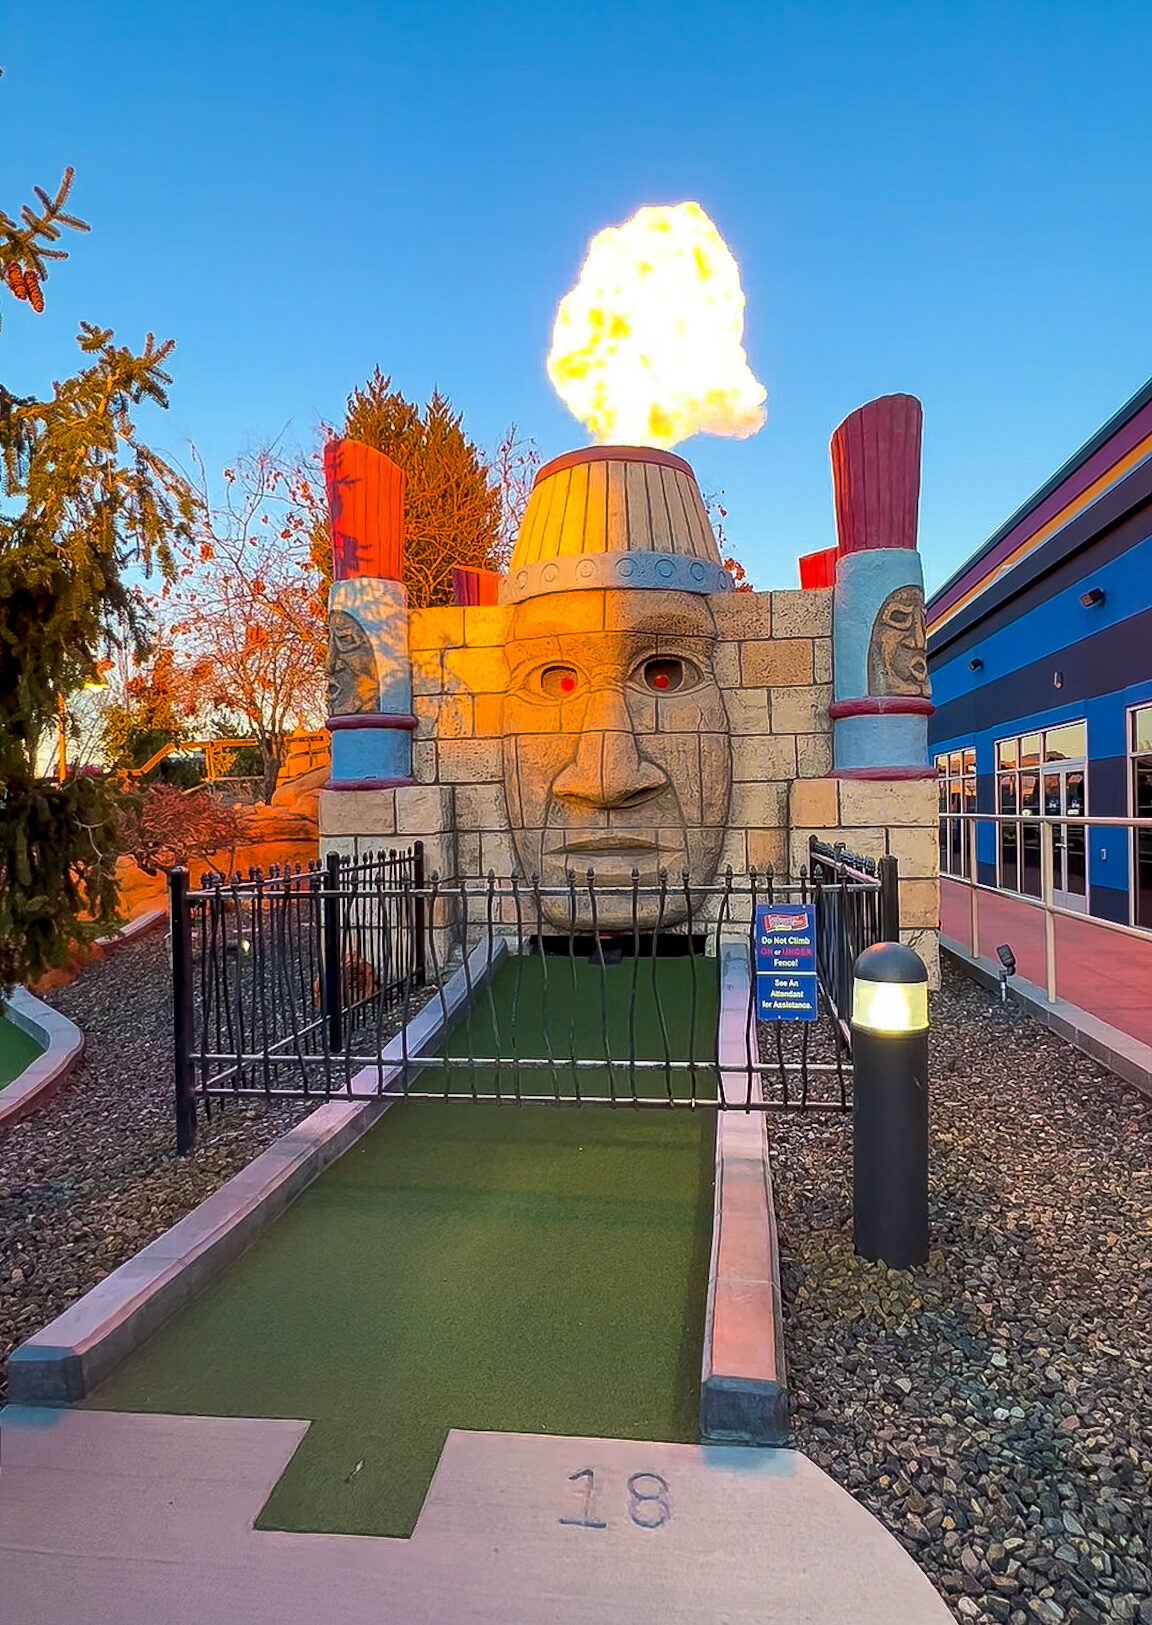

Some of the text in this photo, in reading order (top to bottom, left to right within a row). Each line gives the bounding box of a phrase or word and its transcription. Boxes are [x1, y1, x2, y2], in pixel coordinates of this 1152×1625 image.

[761, 935, 810, 945] Do Not Climb
[761, 947, 773, 956] ON
[782, 947, 811, 956] UNDER
[773, 958, 798, 967] Fence!
[774, 979, 799, 987] See An
[770, 990, 804, 998] Attendant
[762, 1000, 773, 1008] for
[558, 1468, 671, 1528] 18
